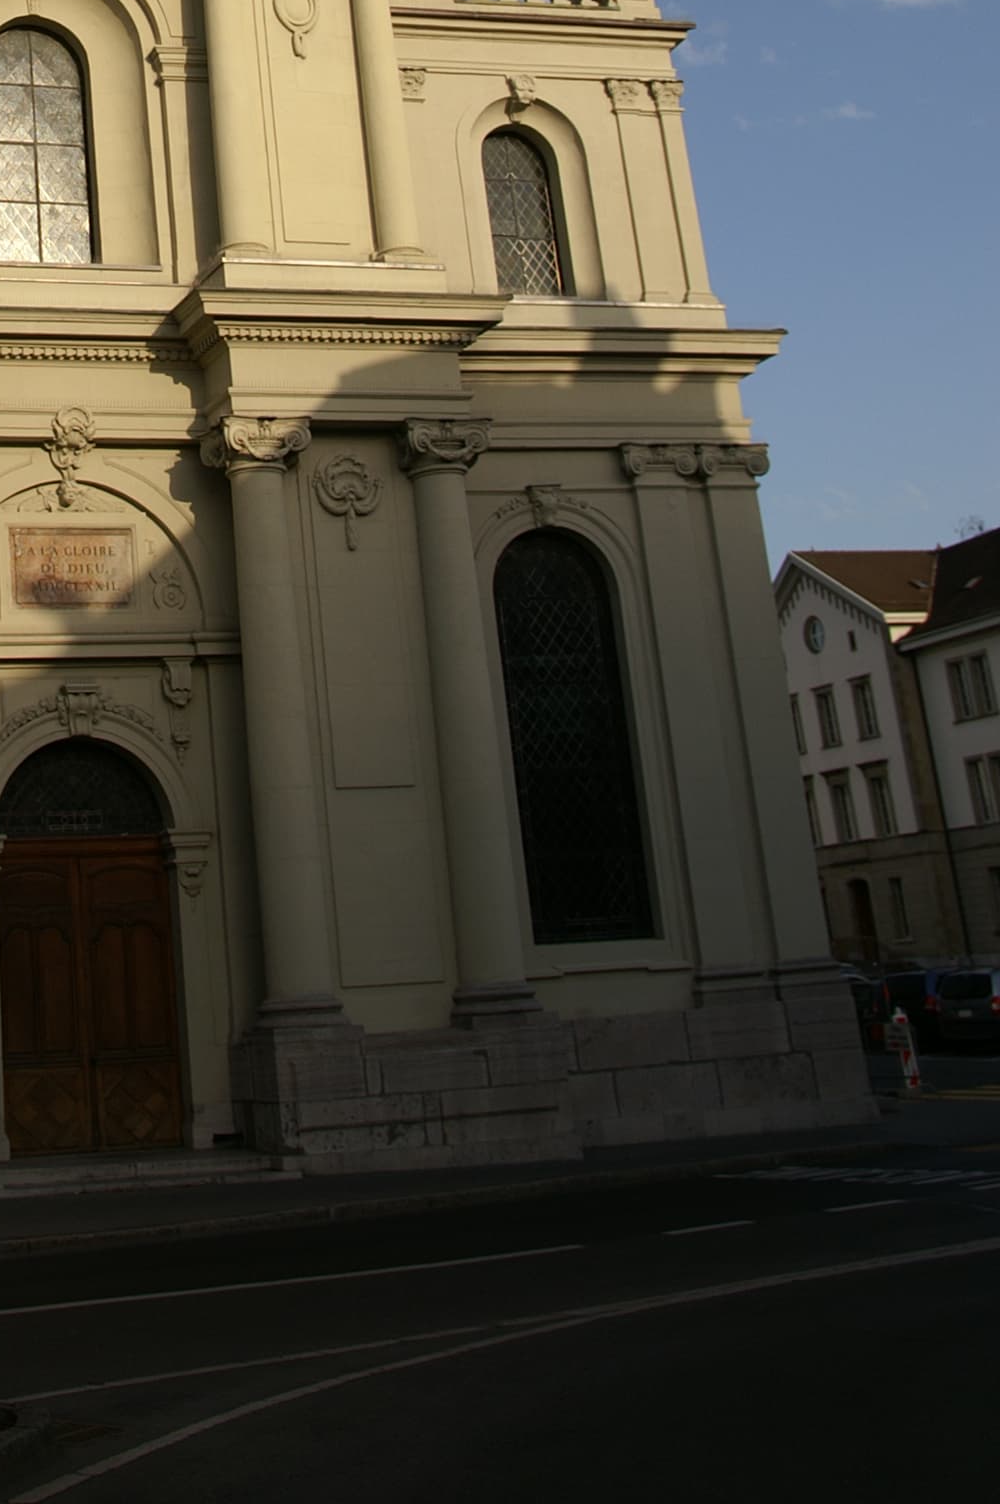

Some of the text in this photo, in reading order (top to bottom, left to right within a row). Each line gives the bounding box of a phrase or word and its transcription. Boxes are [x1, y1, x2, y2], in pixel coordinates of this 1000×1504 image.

[27, 546, 116, 556] A LA GLOIRE
[40, 563, 56, 574] DE
